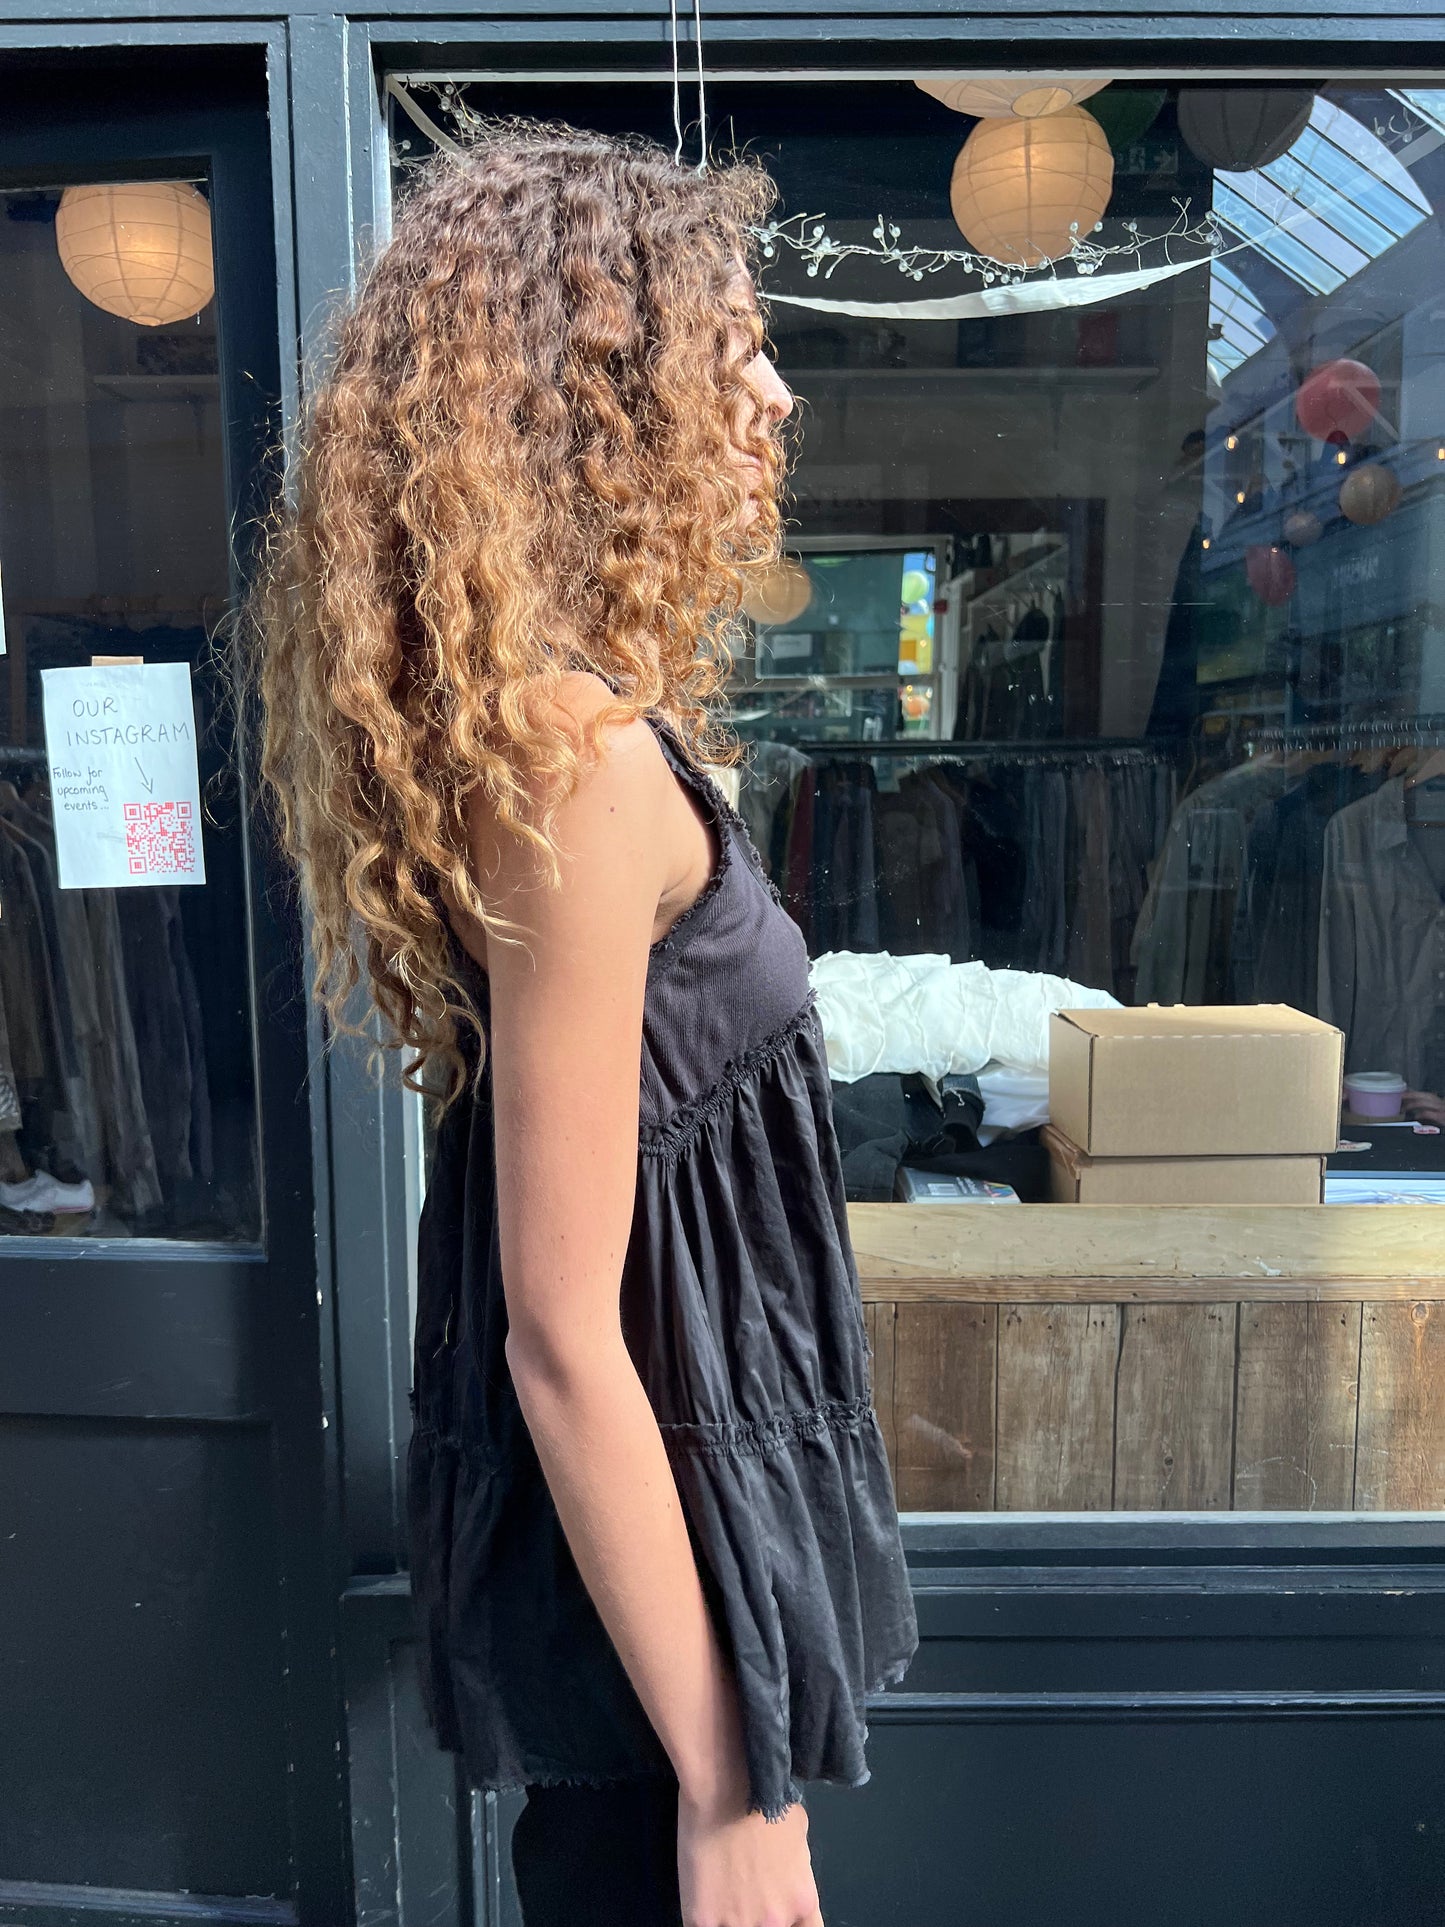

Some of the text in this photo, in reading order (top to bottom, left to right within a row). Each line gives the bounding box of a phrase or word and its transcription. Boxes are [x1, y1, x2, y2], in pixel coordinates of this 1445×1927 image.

[72, 697, 118, 718] OUR
[67, 722, 190, 746] INSTAGRAM
[52, 766, 103, 786] Follow for
[57, 785, 109, 802] upcoming
